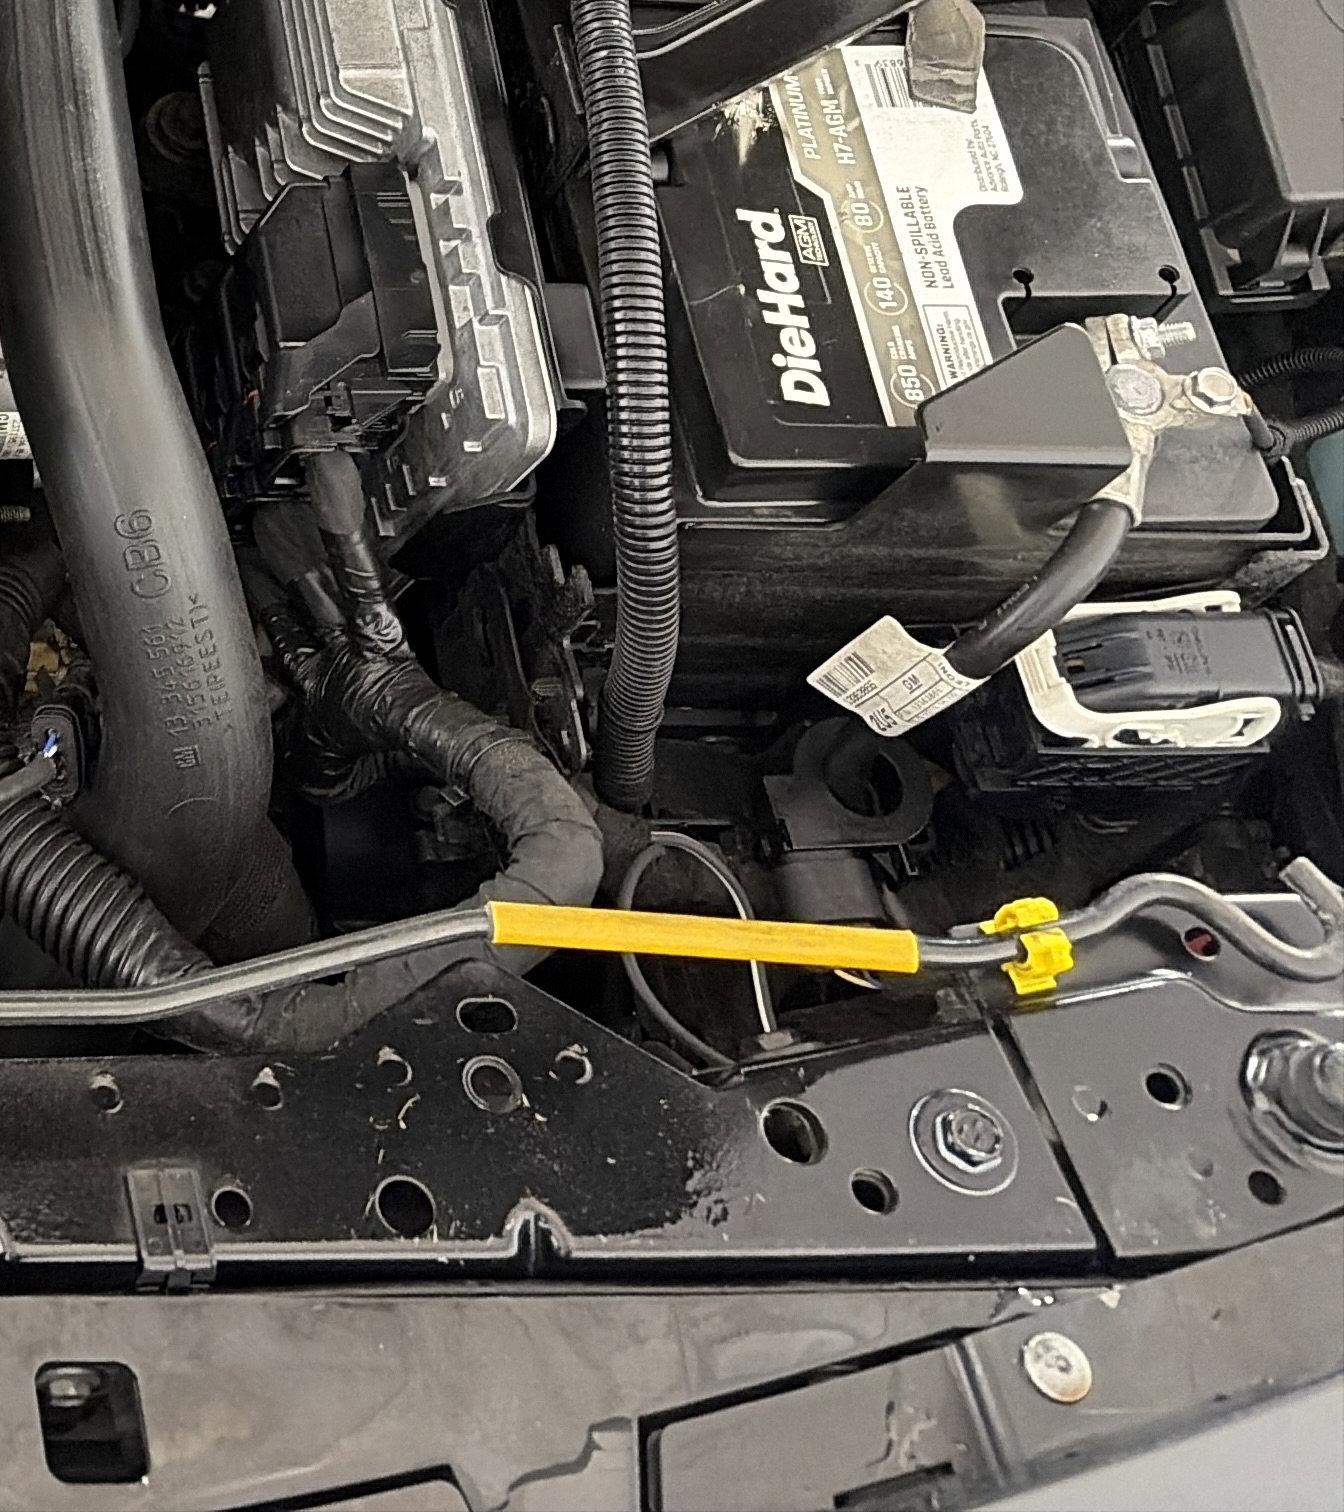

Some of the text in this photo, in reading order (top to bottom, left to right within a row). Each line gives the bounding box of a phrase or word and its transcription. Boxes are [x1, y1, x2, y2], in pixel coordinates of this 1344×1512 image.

[783, 72, 821, 160] PLATINUM
[820, 98, 856, 164] H7-AGM
[793, 218, 814, 261] AGM
[851, 202, 874, 227] 80
[895, 186, 939, 288] NON-SPILLABLE
[912, 186, 954, 288] Lead Acid Battery
[736, 208, 831, 407] DieHard
[872, 277, 897, 309] 140
[937, 324, 958, 379] WARNING:
[897, 365, 925, 401] 850
[114, 509, 171, 599] CB6
[902, 674, 919, 691] GM
